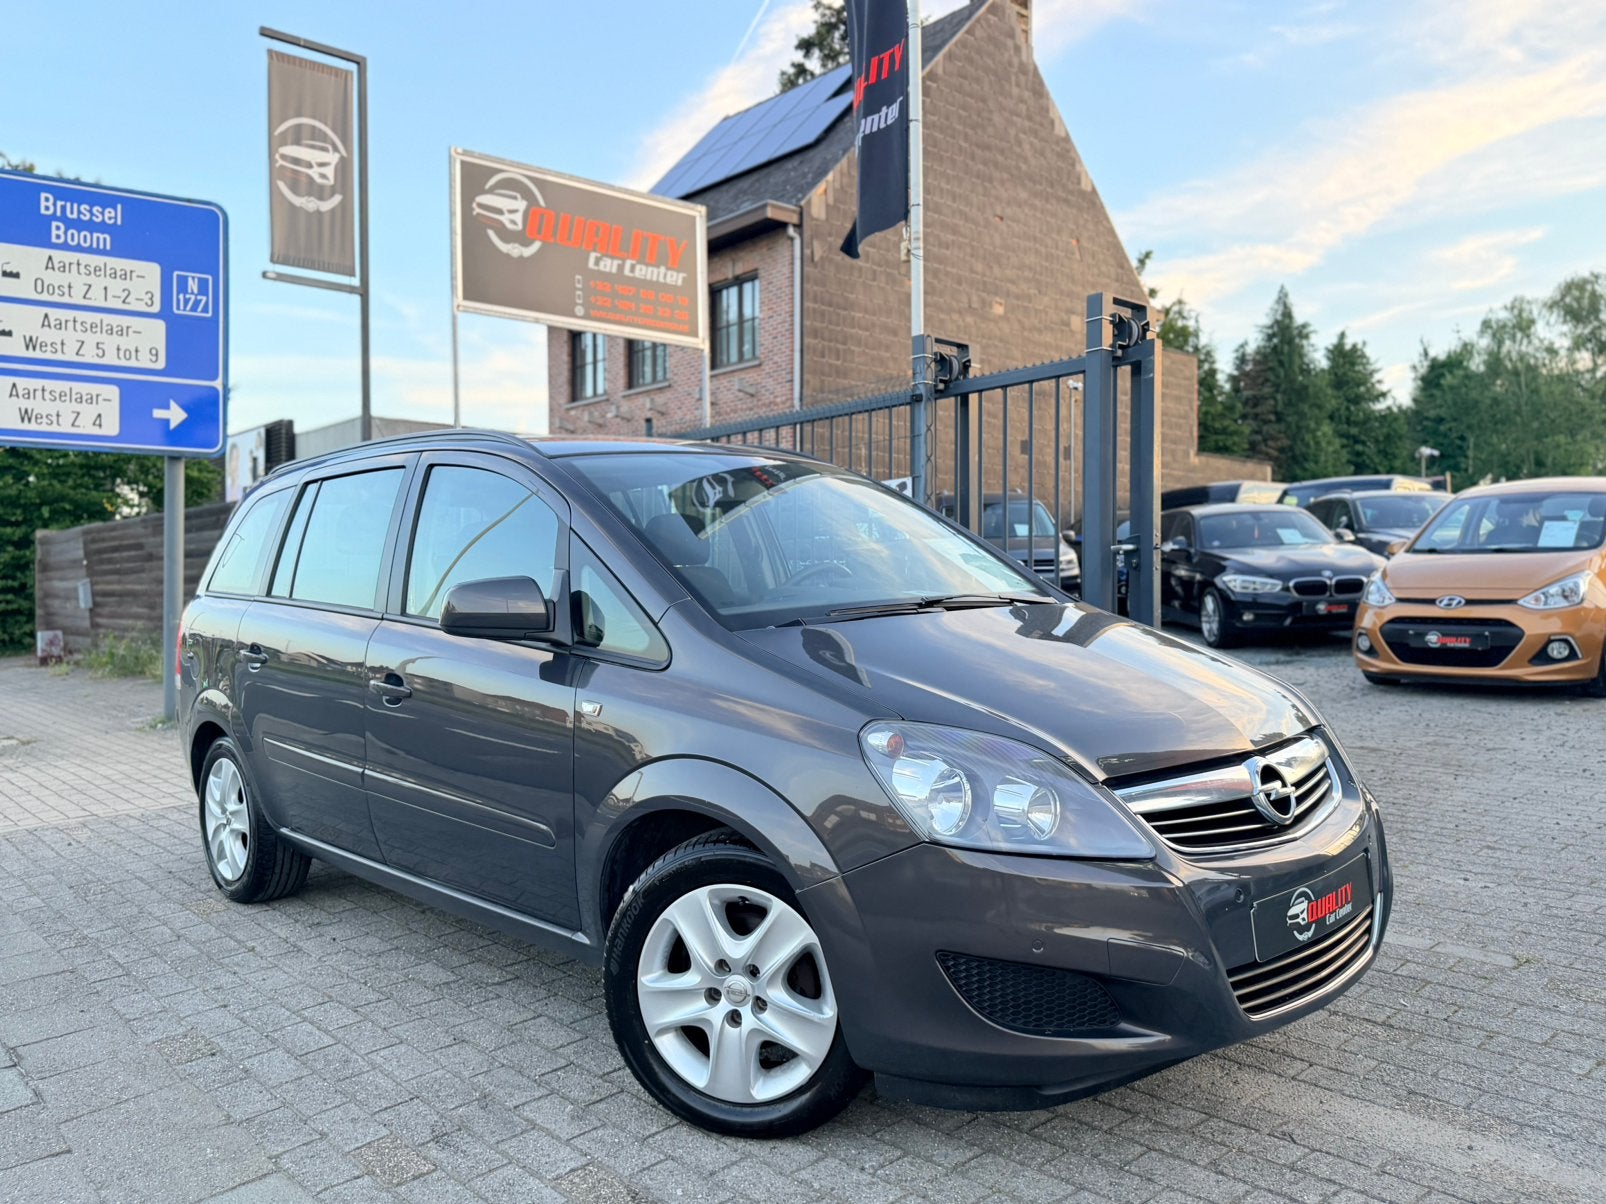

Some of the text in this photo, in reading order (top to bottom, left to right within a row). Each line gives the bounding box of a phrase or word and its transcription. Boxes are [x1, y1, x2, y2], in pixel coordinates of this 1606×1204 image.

[39, 192, 122, 226] Brussel
[51, 221, 111, 250] Boom
[525, 206, 688, 269] QUALITY
[44, 254, 146, 282] Aartselaar-
[588, 251, 688, 286] Car Center
[33, 276, 73, 298] Oost
[103, 285, 154, 308] 1-2-3
[187, 276, 198, 294] N
[179, 293, 207, 313] 177
[40, 312, 142, 338] Aartselaar-
[23, 334, 66, 355] West
[116, 343, 141, 362] tot
[148, 346, 159, 364] 9
[8, 381, 112, 406] Aartselaar-
[18, 406, 62, 427] West
[92, 412, 103, 430] 4
[1308, 882, 1352, 922] QUALITY
